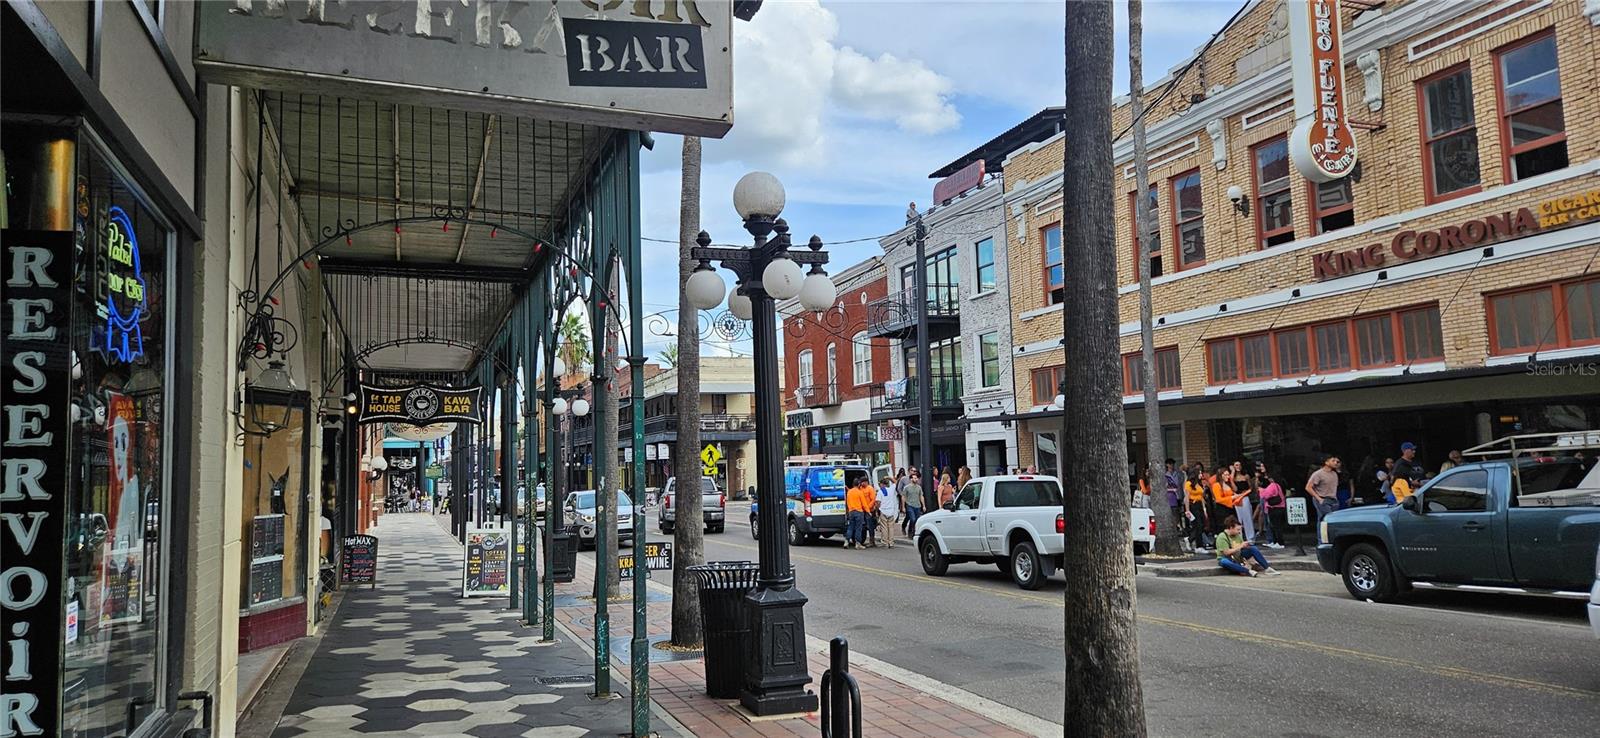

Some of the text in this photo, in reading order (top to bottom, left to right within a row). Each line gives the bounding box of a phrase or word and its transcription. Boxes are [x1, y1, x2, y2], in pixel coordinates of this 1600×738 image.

[576, 34, 698, 73] BAR
[1319, 59, 1341, 154] FUENTE
[1540, 212, 1569, 228] BAR
[1311, 207, 1541, 279] KING CORONA
[382, 395, 402, 404] TAP
[444, 396, 471, 405] KAVA
[369, 404, 401, 413] HOUSE
[444, 405, 470, 413] BAR
[645, 545, 668, 557] EER &
[647, 557, 670, 568] WINE
